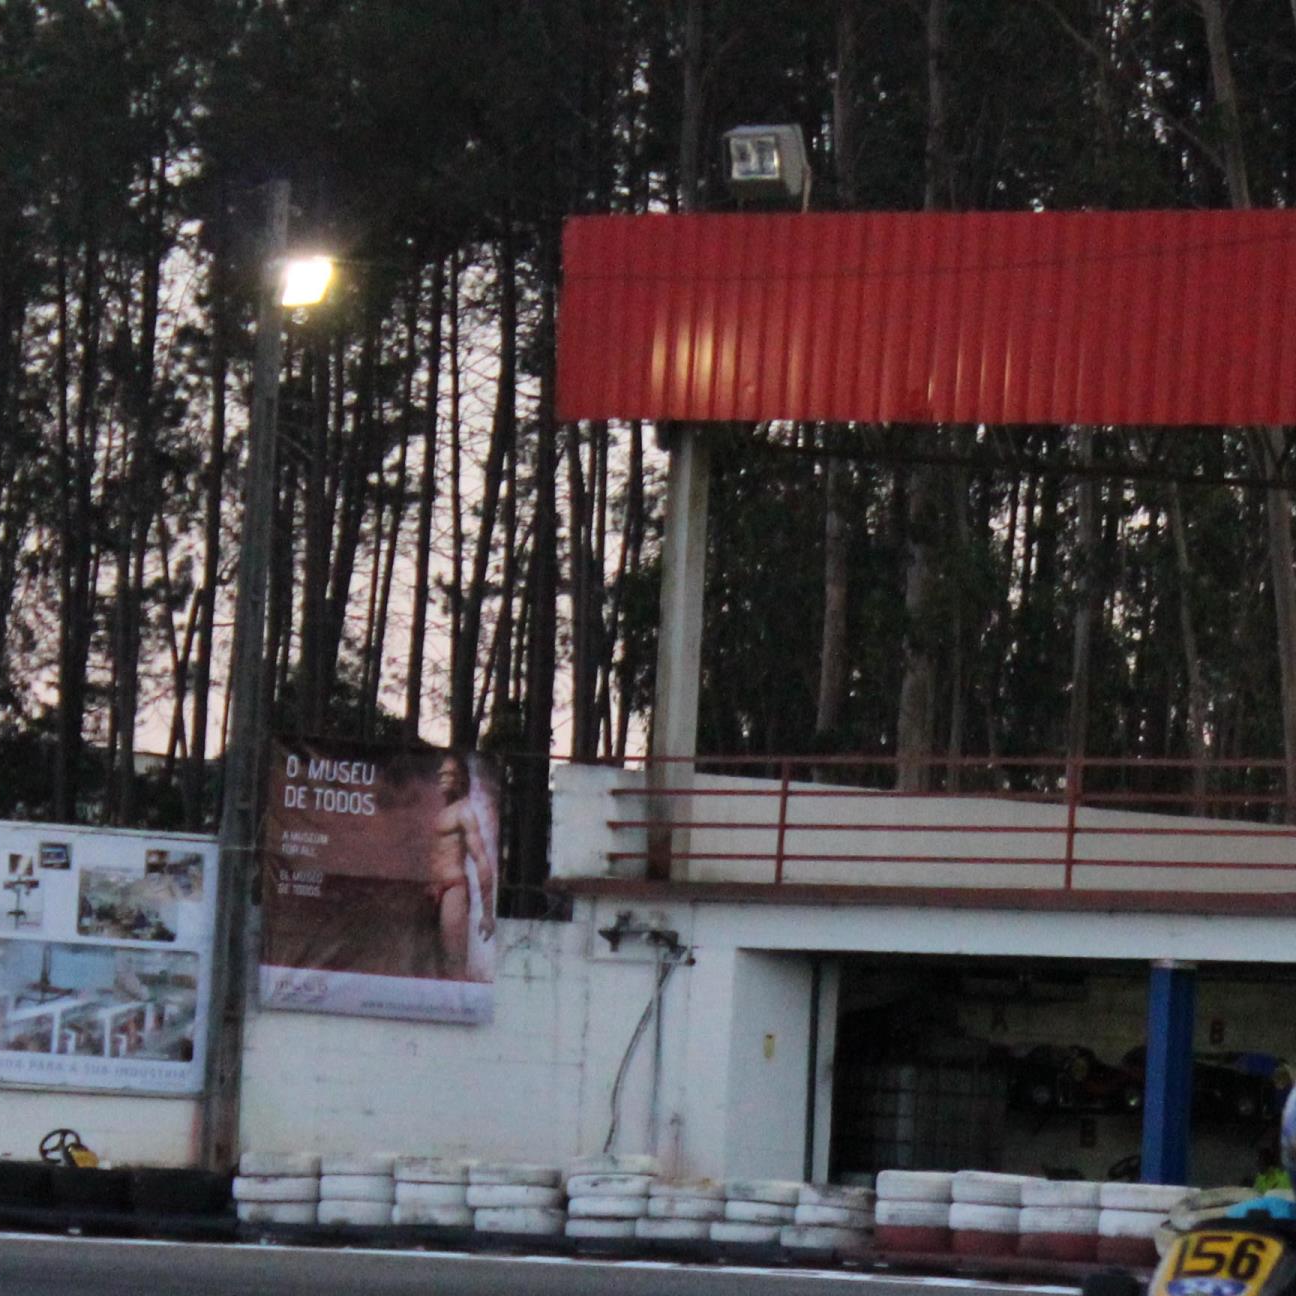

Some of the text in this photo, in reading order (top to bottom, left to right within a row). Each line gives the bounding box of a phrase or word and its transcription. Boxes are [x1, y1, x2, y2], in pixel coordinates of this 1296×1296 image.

[286, 755, 375, 785] O MUSEU
[284, 785, 376, 816] DE TODOS
